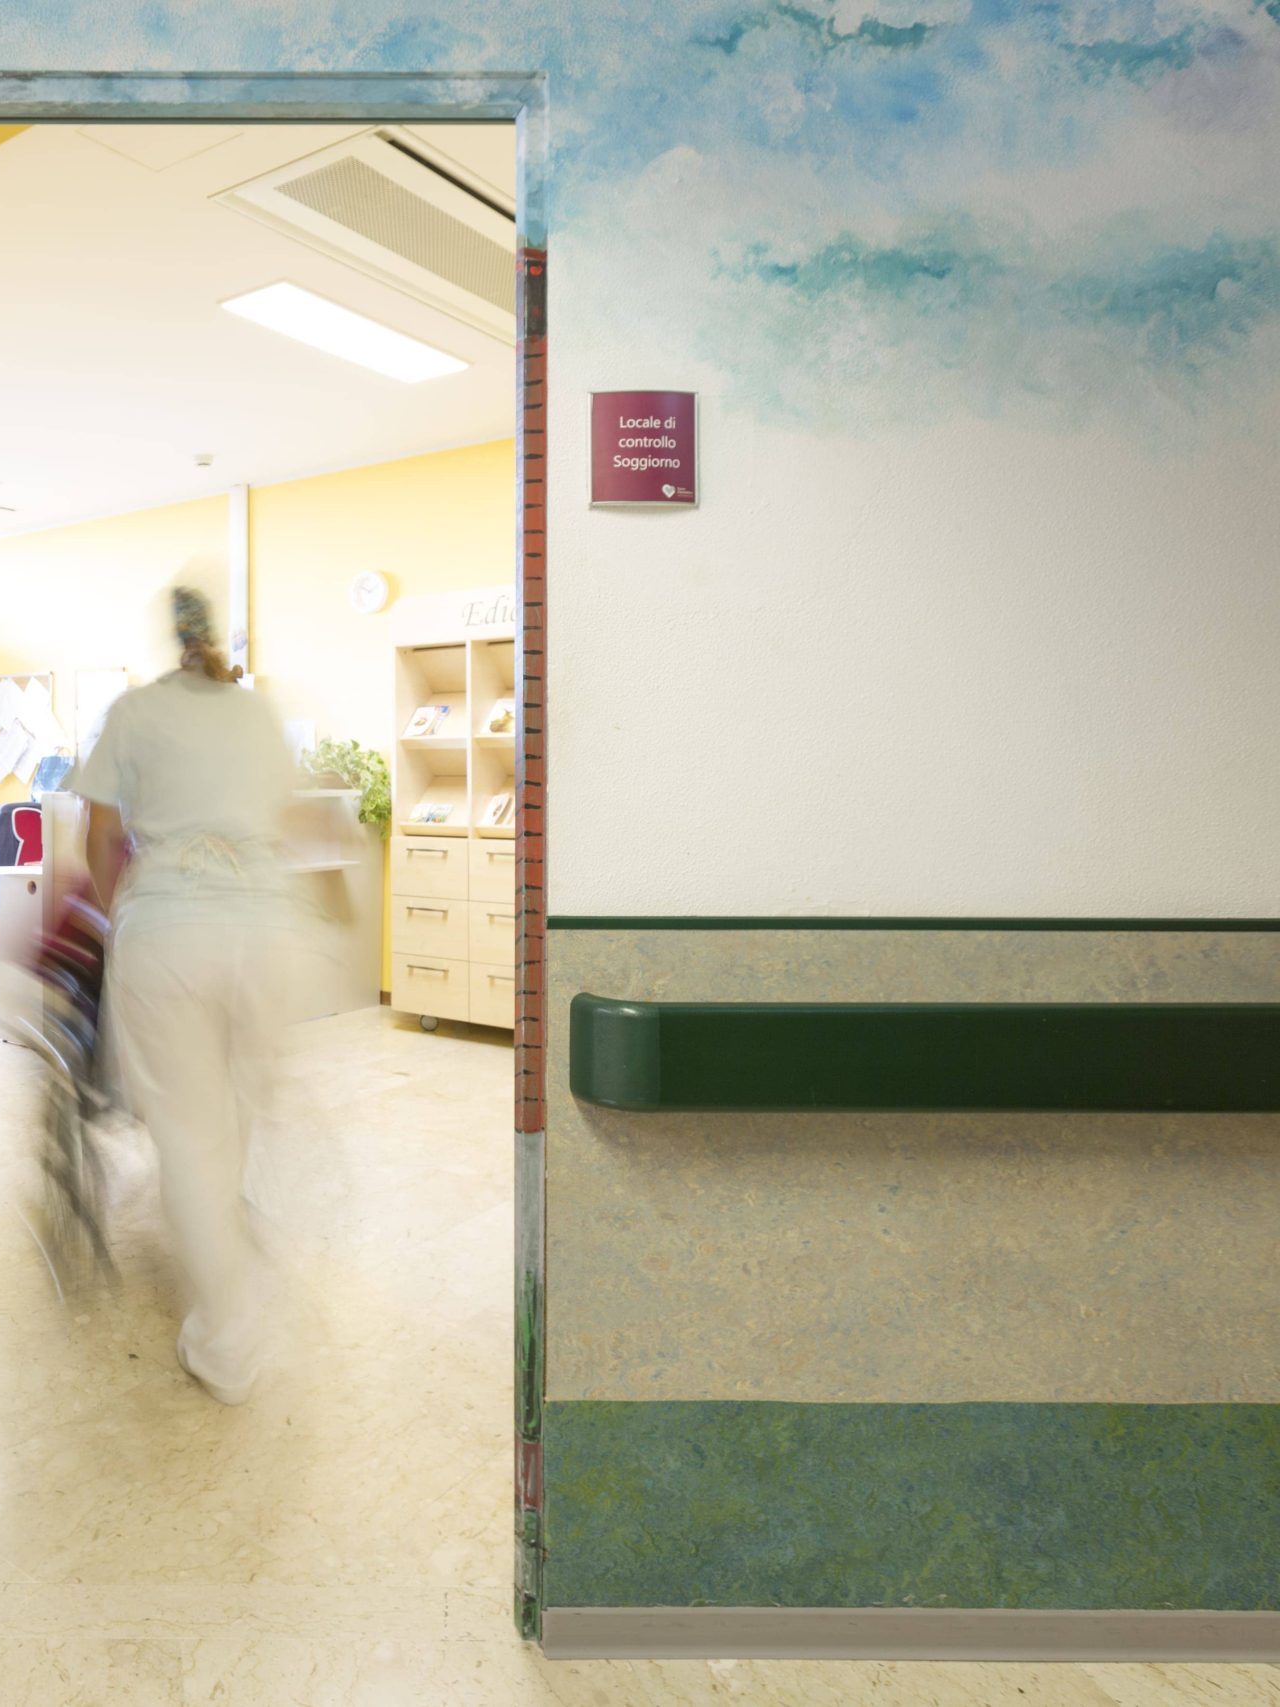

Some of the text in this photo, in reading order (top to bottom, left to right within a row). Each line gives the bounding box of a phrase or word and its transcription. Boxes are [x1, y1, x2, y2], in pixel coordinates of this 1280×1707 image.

[619, 416, 676, 429] Locale di
[618, 436, 676, 449] controllo
[613, 455, 680, 471] Soggiorno
